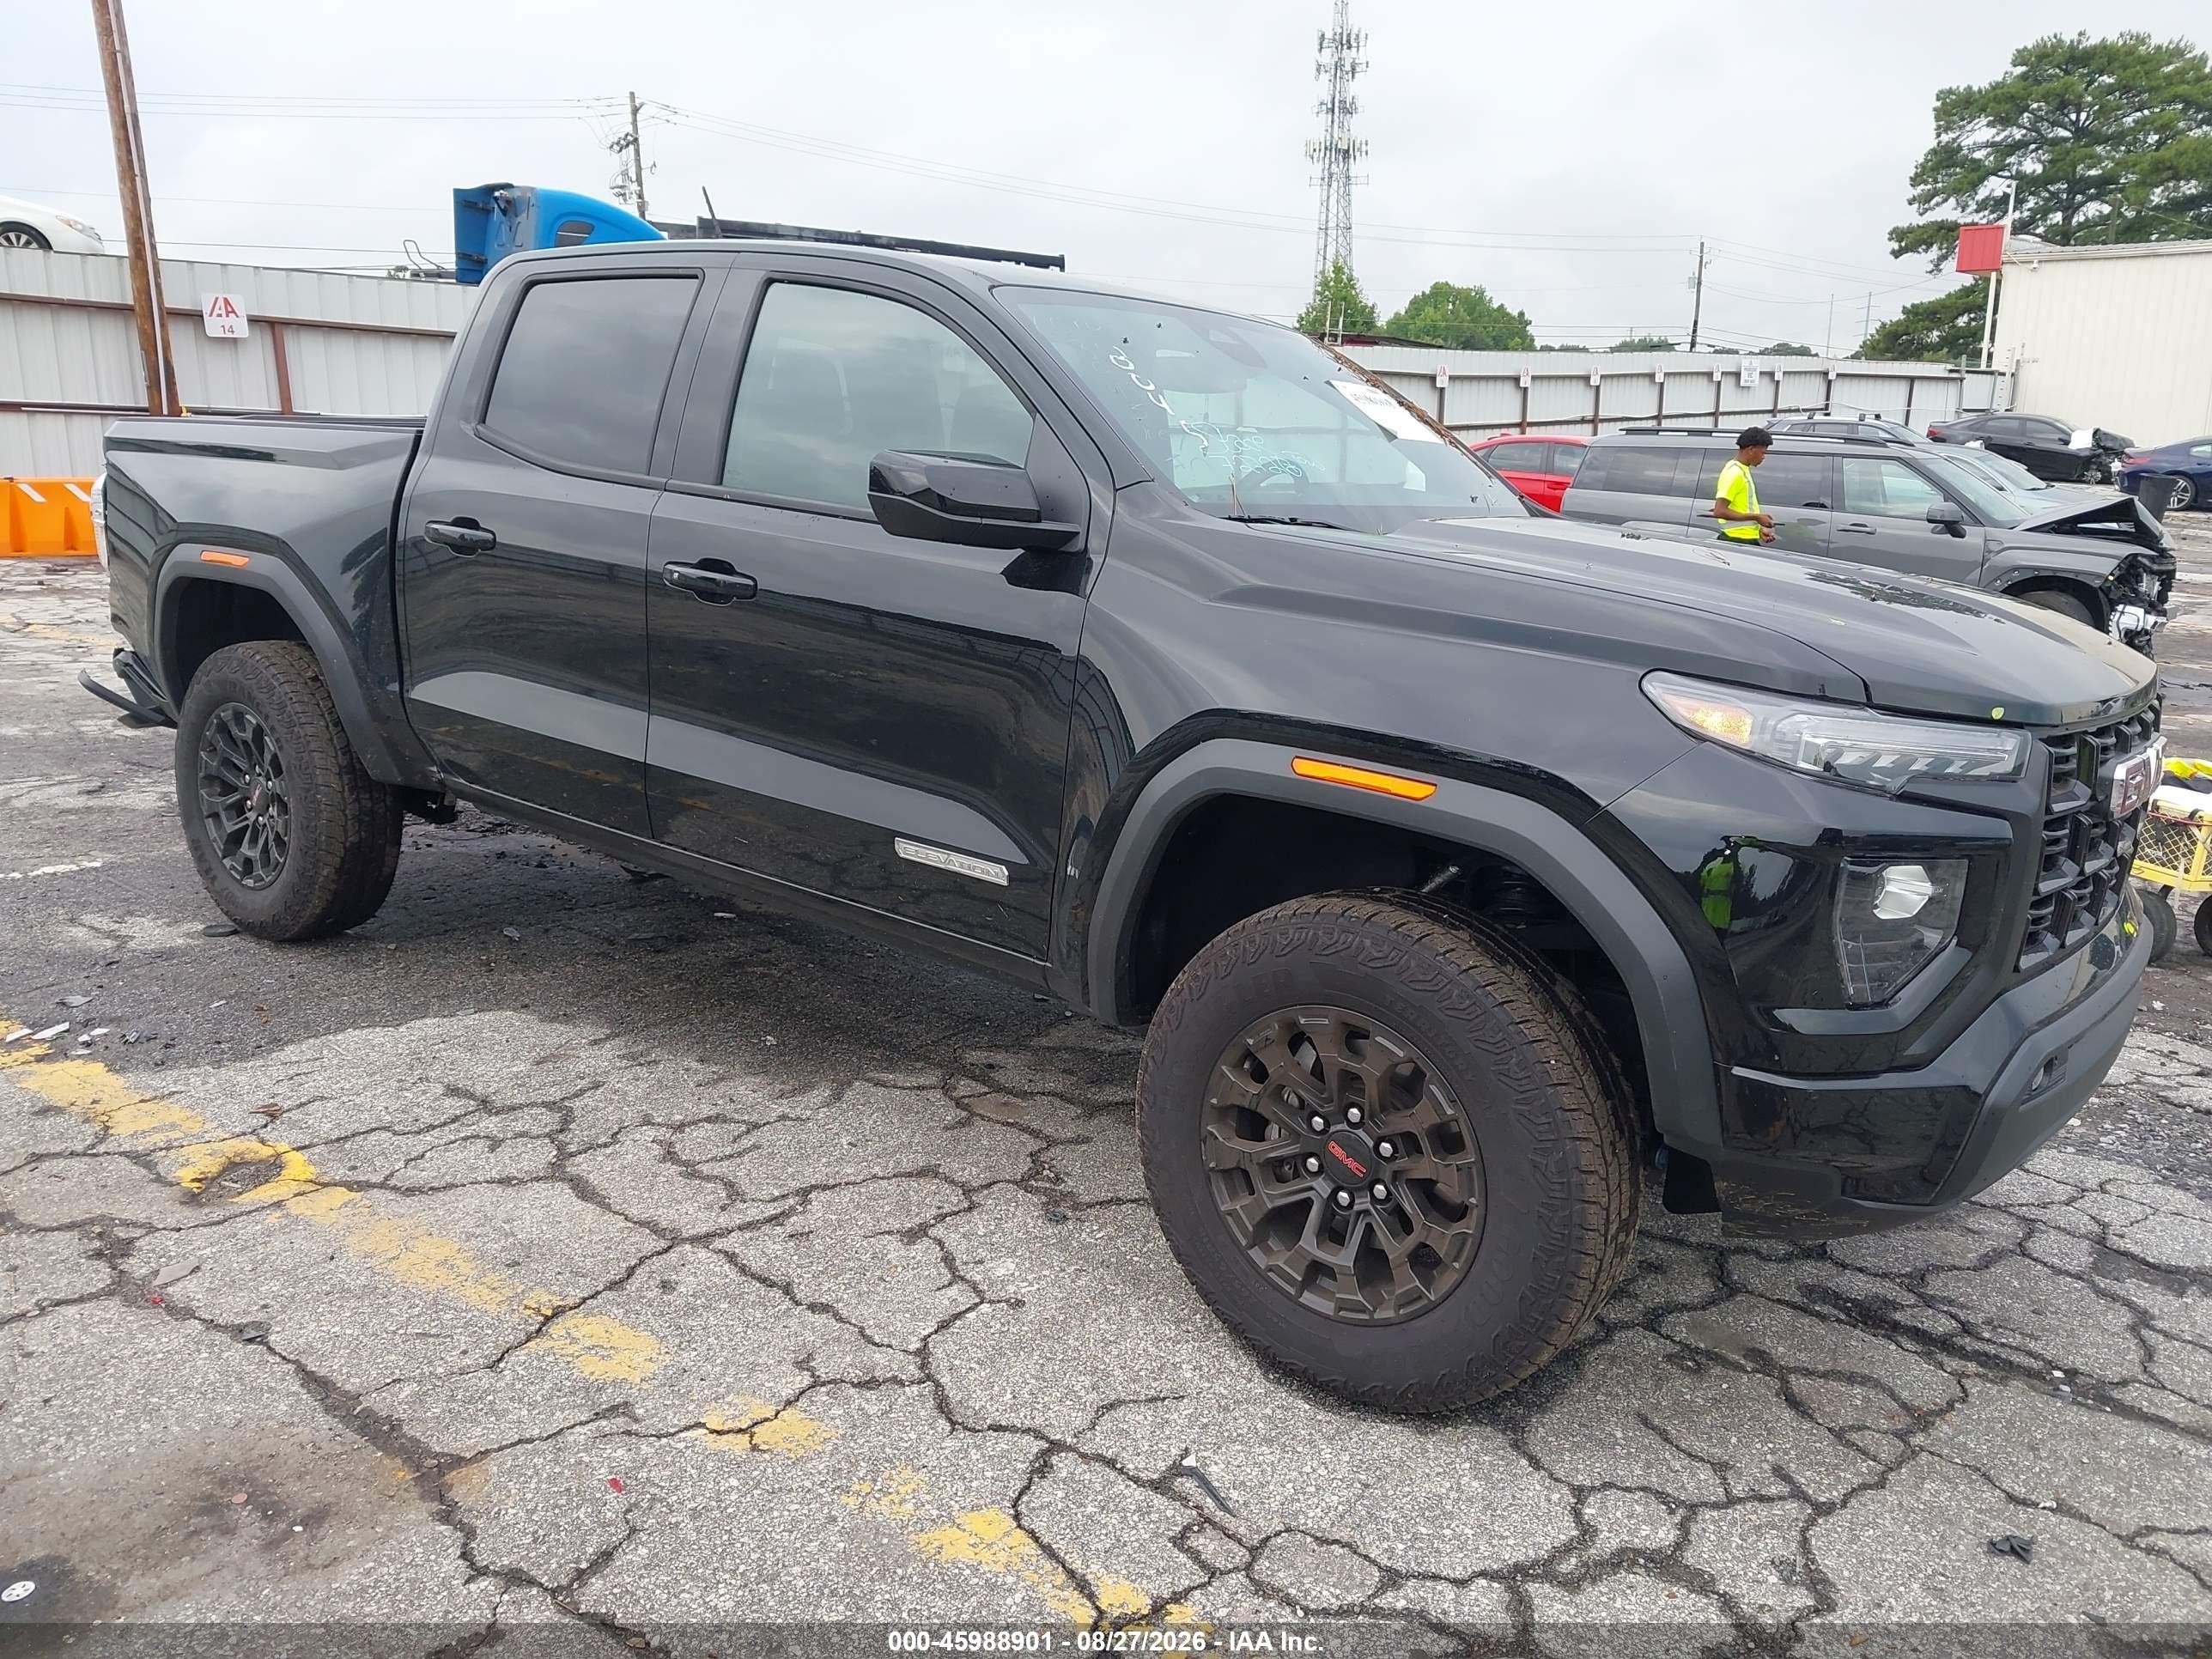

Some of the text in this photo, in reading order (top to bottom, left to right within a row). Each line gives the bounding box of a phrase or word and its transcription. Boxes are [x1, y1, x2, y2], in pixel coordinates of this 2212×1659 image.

[220, 325, 234, 335] 14
[902, 845, 1006, 882] ELEVATION
[1328, 1140, 1367, 1178] GMC
